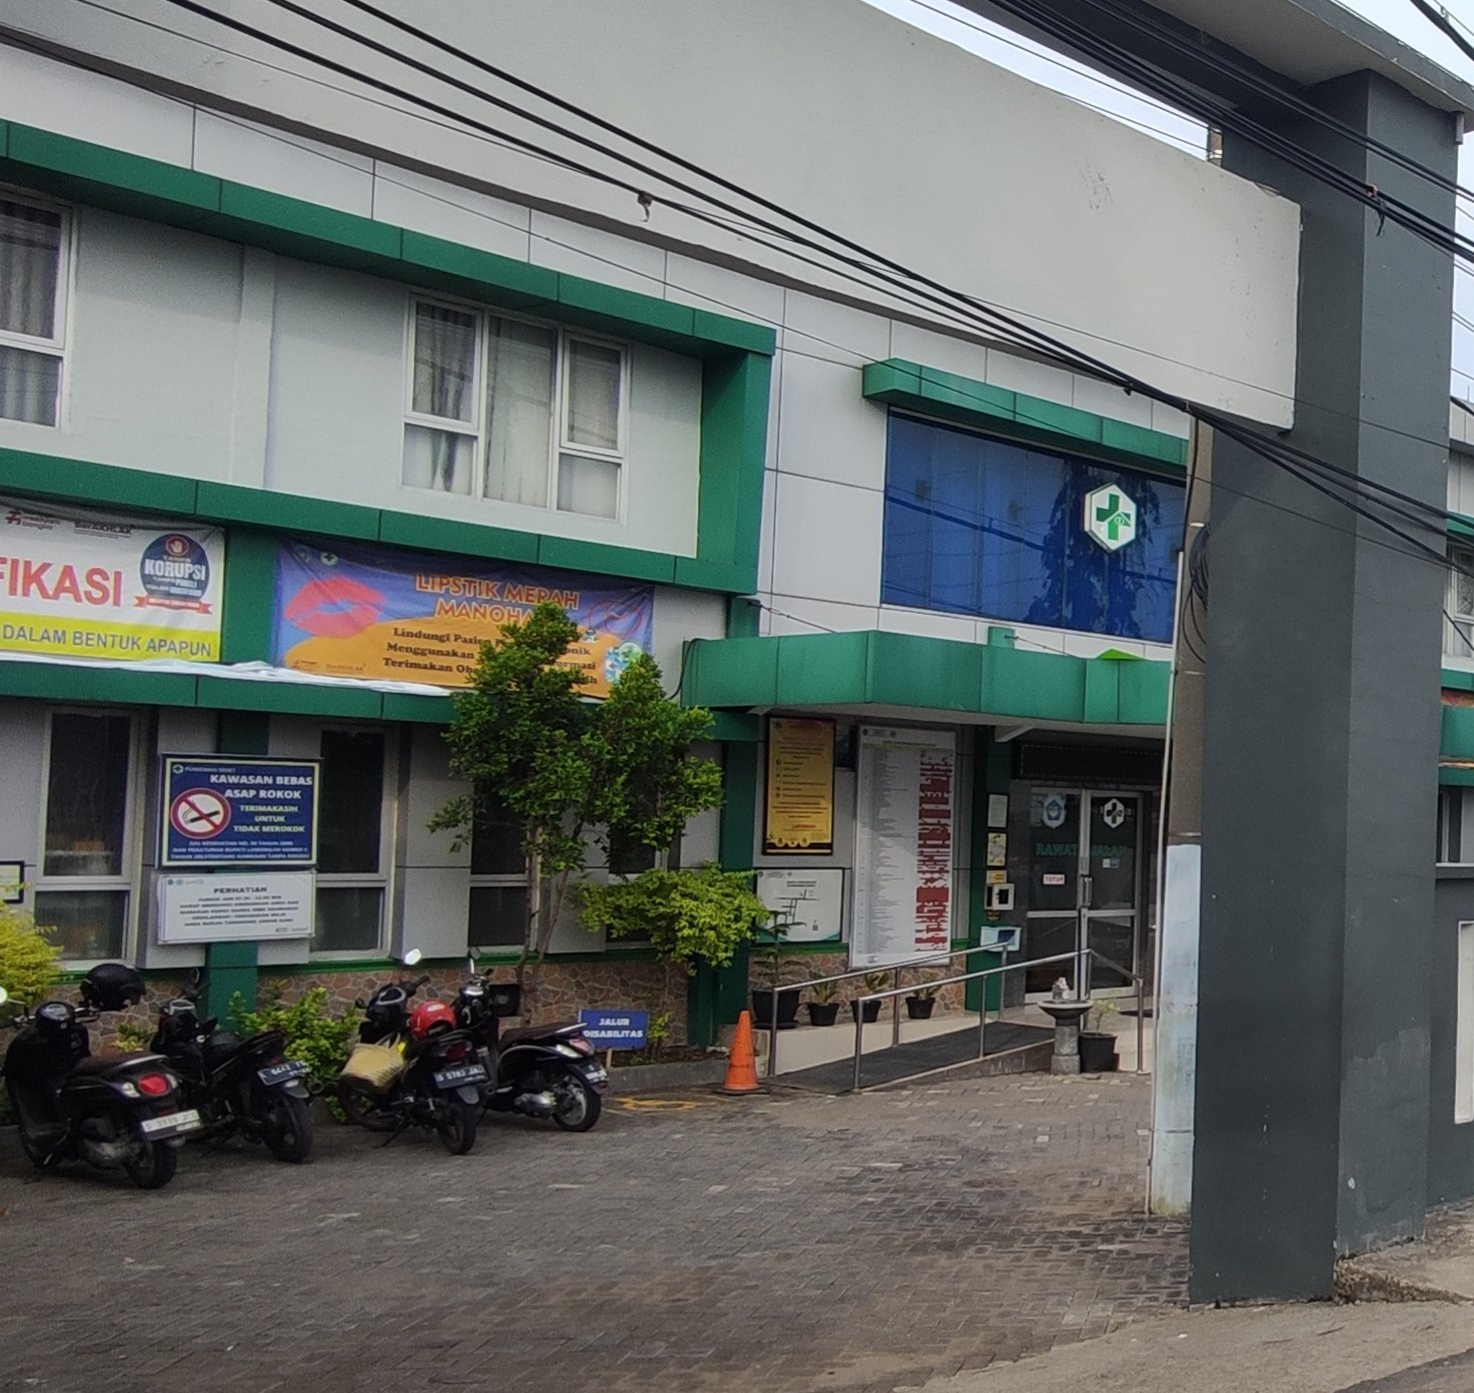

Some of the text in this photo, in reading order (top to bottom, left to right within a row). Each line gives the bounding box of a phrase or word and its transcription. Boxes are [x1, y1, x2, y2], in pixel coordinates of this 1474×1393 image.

[144, 559, 206, 581] KORUPSI
[415, 573, 580, 610] LIPSTIK MERAH
[3, 624, 211, 657] DALAM BENTUK APAPUN
[393, 627, 451, 644] Lindungi
[386, 642, 475, 659] Menggunakan
[382, 657, 453, 674] Terimakan
[210, 774, 313, 786] KAWASAN BEBAS
[224, 789, 302, 799] ASAP ROKOK
[599, 1018, 629, 1026] JALUR
[583, 1030, 643, 1038] DISABILITAS
